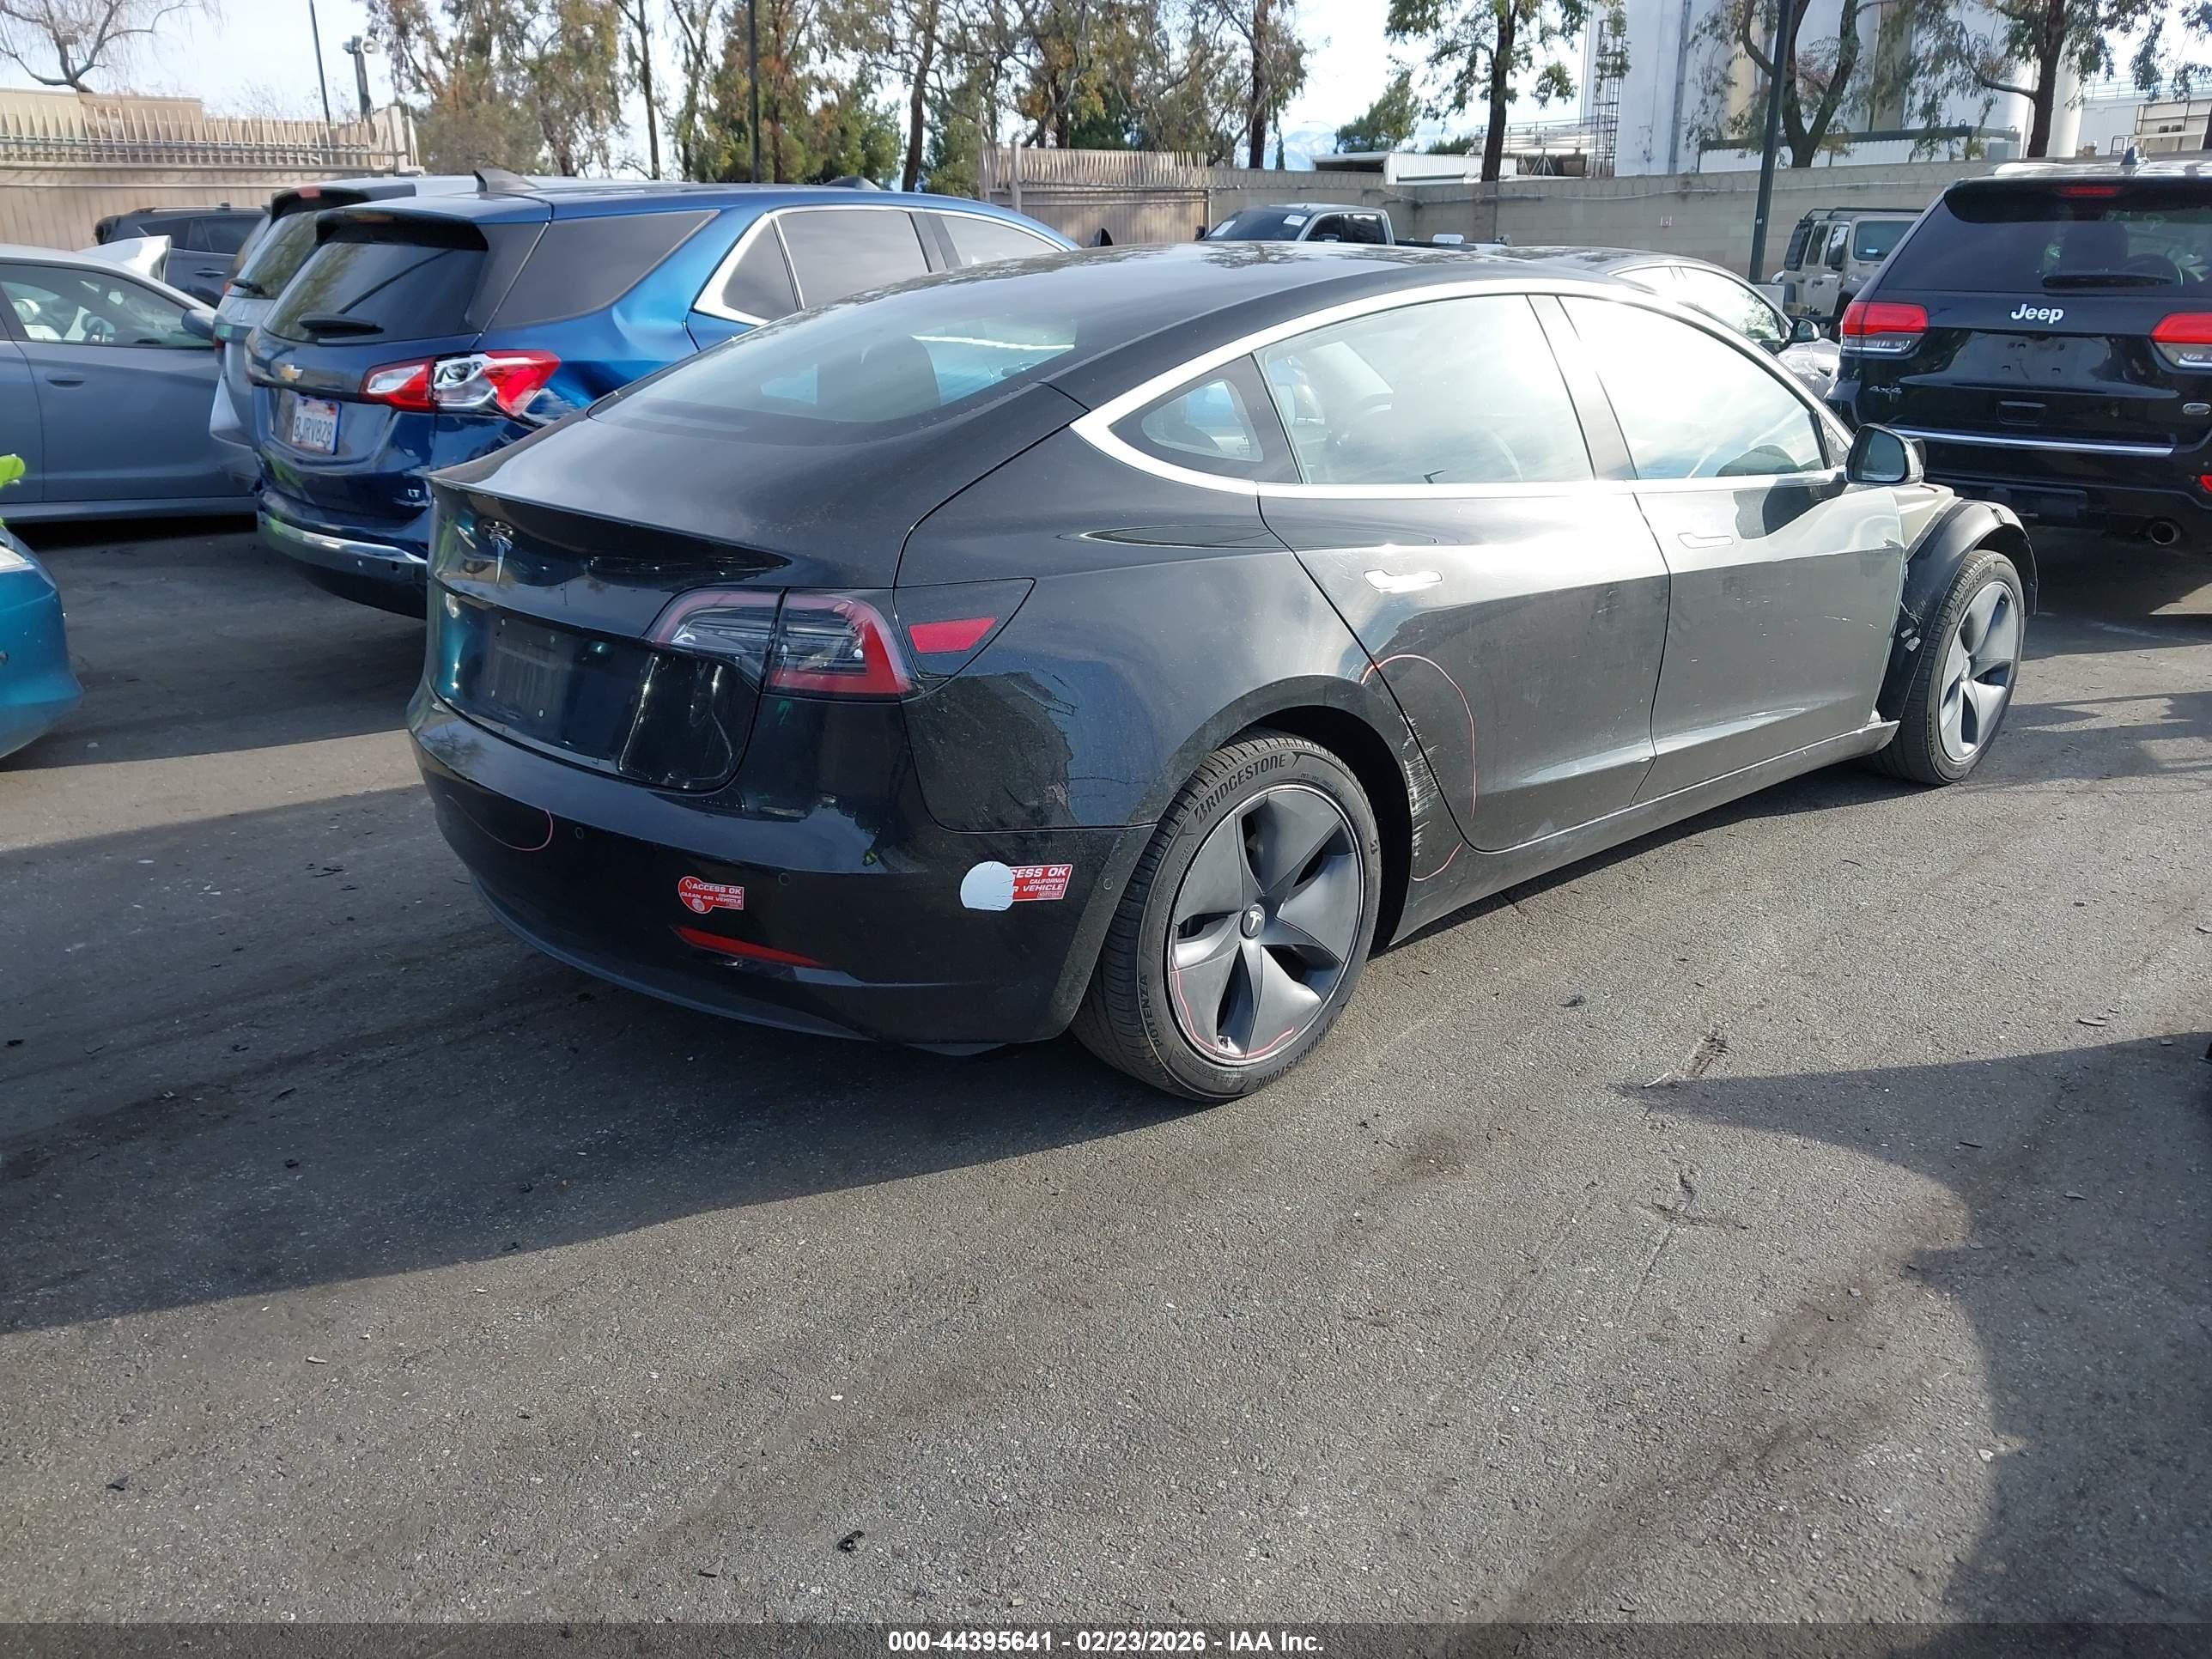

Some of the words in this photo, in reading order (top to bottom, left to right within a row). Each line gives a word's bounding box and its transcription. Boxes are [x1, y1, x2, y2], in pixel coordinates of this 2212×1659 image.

[2011, 303, 2064, 324] Jeep
[1194, 754, 1286, 824] BRIDGESTONE
[1048, 866, 1069, 876] OK
[692, 883, 726, 893] ACCESS
[1023, 884, 1064, 892] VEHICLE
[1139, 974, 1164, 1049] POTENZA
